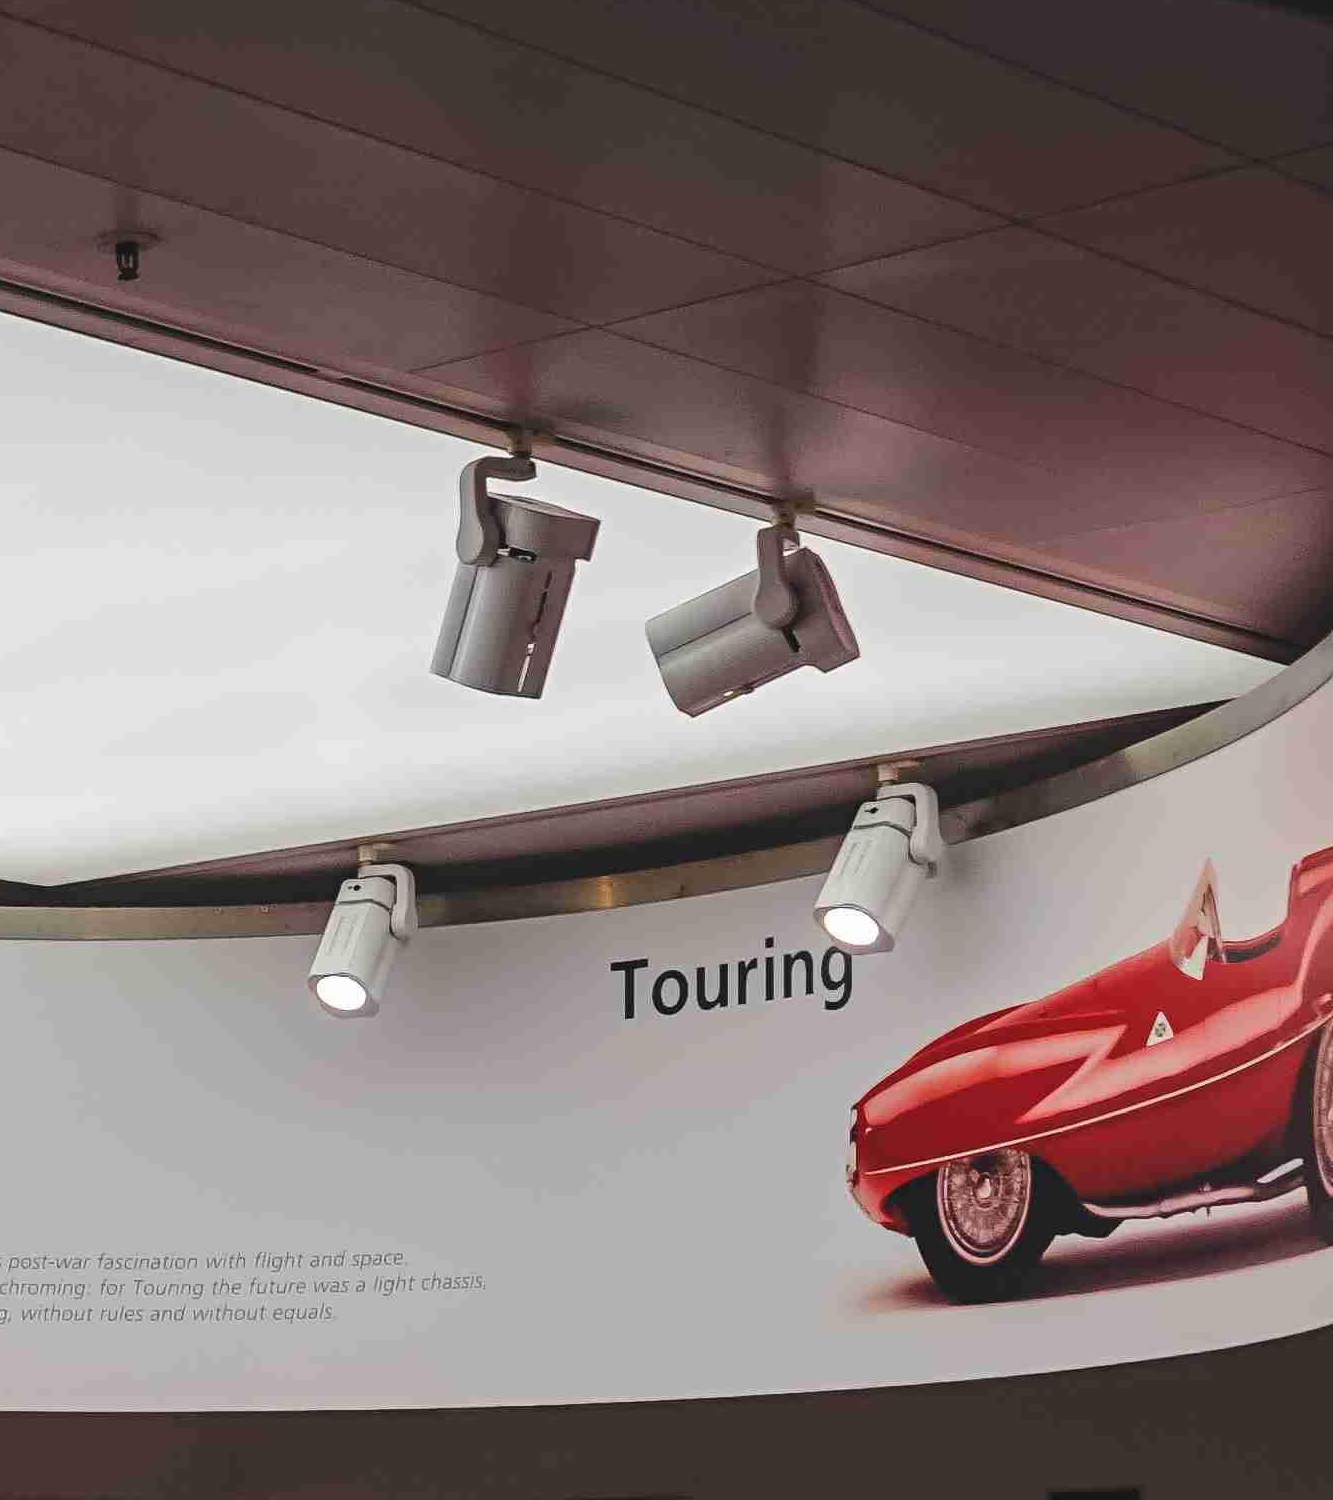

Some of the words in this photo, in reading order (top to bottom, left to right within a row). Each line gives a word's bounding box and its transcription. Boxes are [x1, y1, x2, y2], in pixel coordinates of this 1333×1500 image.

[610, 936, 854, 1020] Touring
[7, 1253, 91, 1274] post-war
[96, 1251, 198, 1269] fascination
[205, 1250, 246, 1269] with
[253, 1250, 304, 1274] flight
[309, 1249, 346, 1268] and
[99, 1278, 126, 1296] for
[132, 1277, 204, 1301] Touring
[211, 1277, 243, 1296] the
[247, 1276, 308, 1295] future
[312, 1279, 350, 1294] was
[355, 1279, 367, 1293] a
[372, 1273, 416, 1297] light
[20, 1303, 94, 1322] without
[99, 1304, 144, 1322] rules
[149, 1304, 186, 1322] and
[191, 1303, 267, 1322] without
